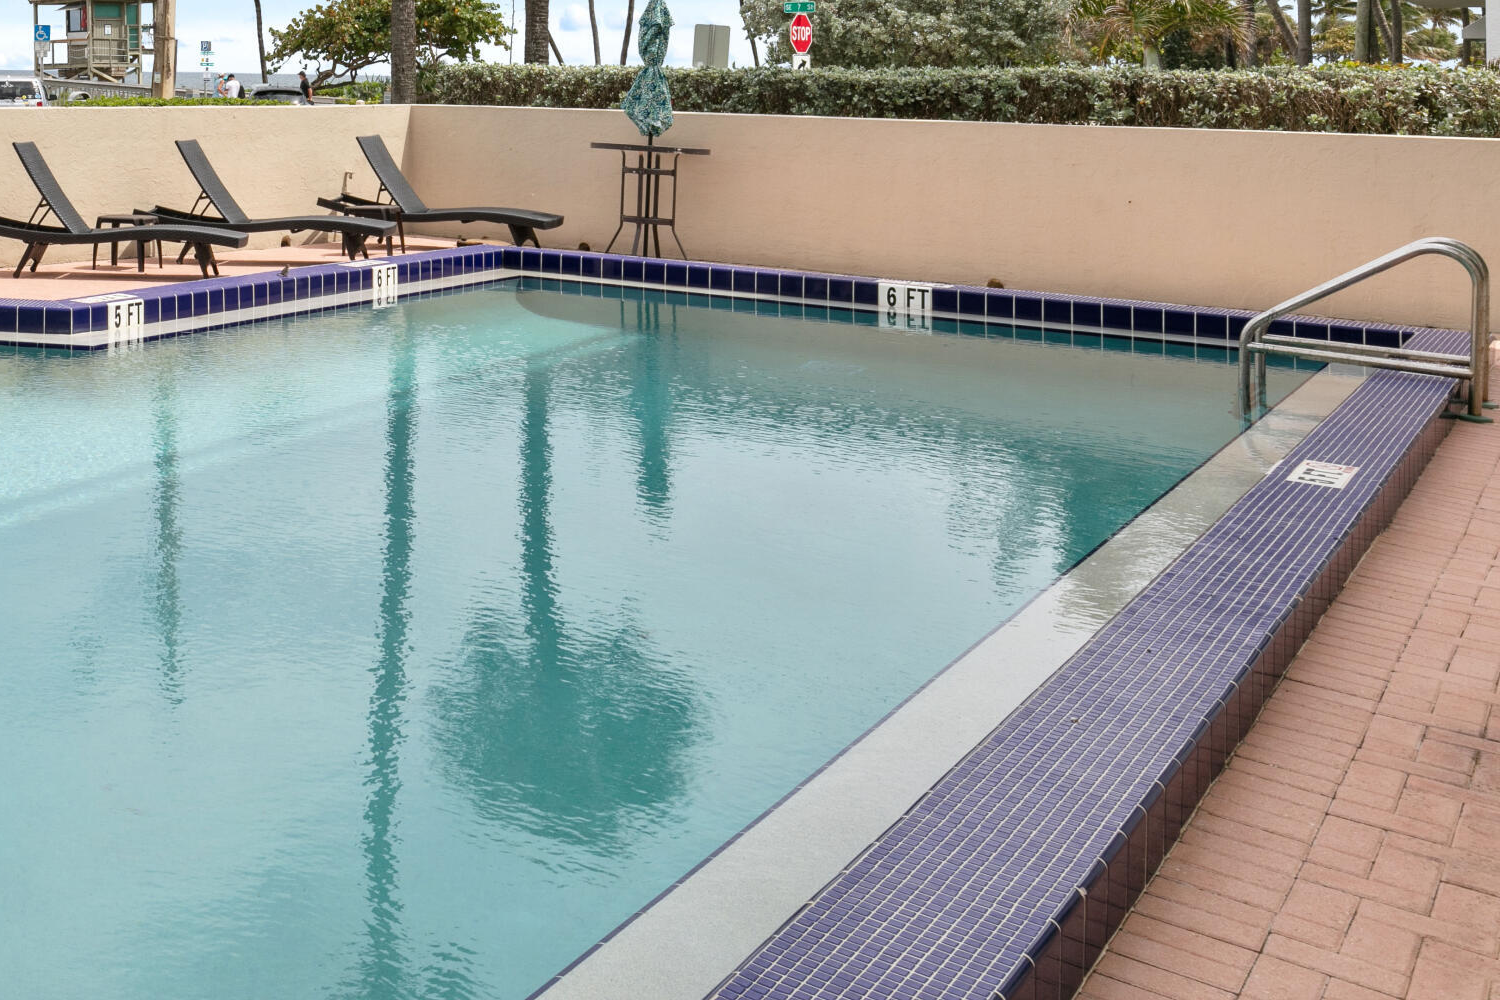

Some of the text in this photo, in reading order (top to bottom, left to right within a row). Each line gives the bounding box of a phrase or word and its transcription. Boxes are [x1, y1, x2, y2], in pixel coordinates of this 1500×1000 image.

[792, 26, 811, 40] STOP
[377, 266, 396, 287] 6 FT
[887, 287, 929, 309] 6 FT
[115, 302, 142, 328] 5 FT
